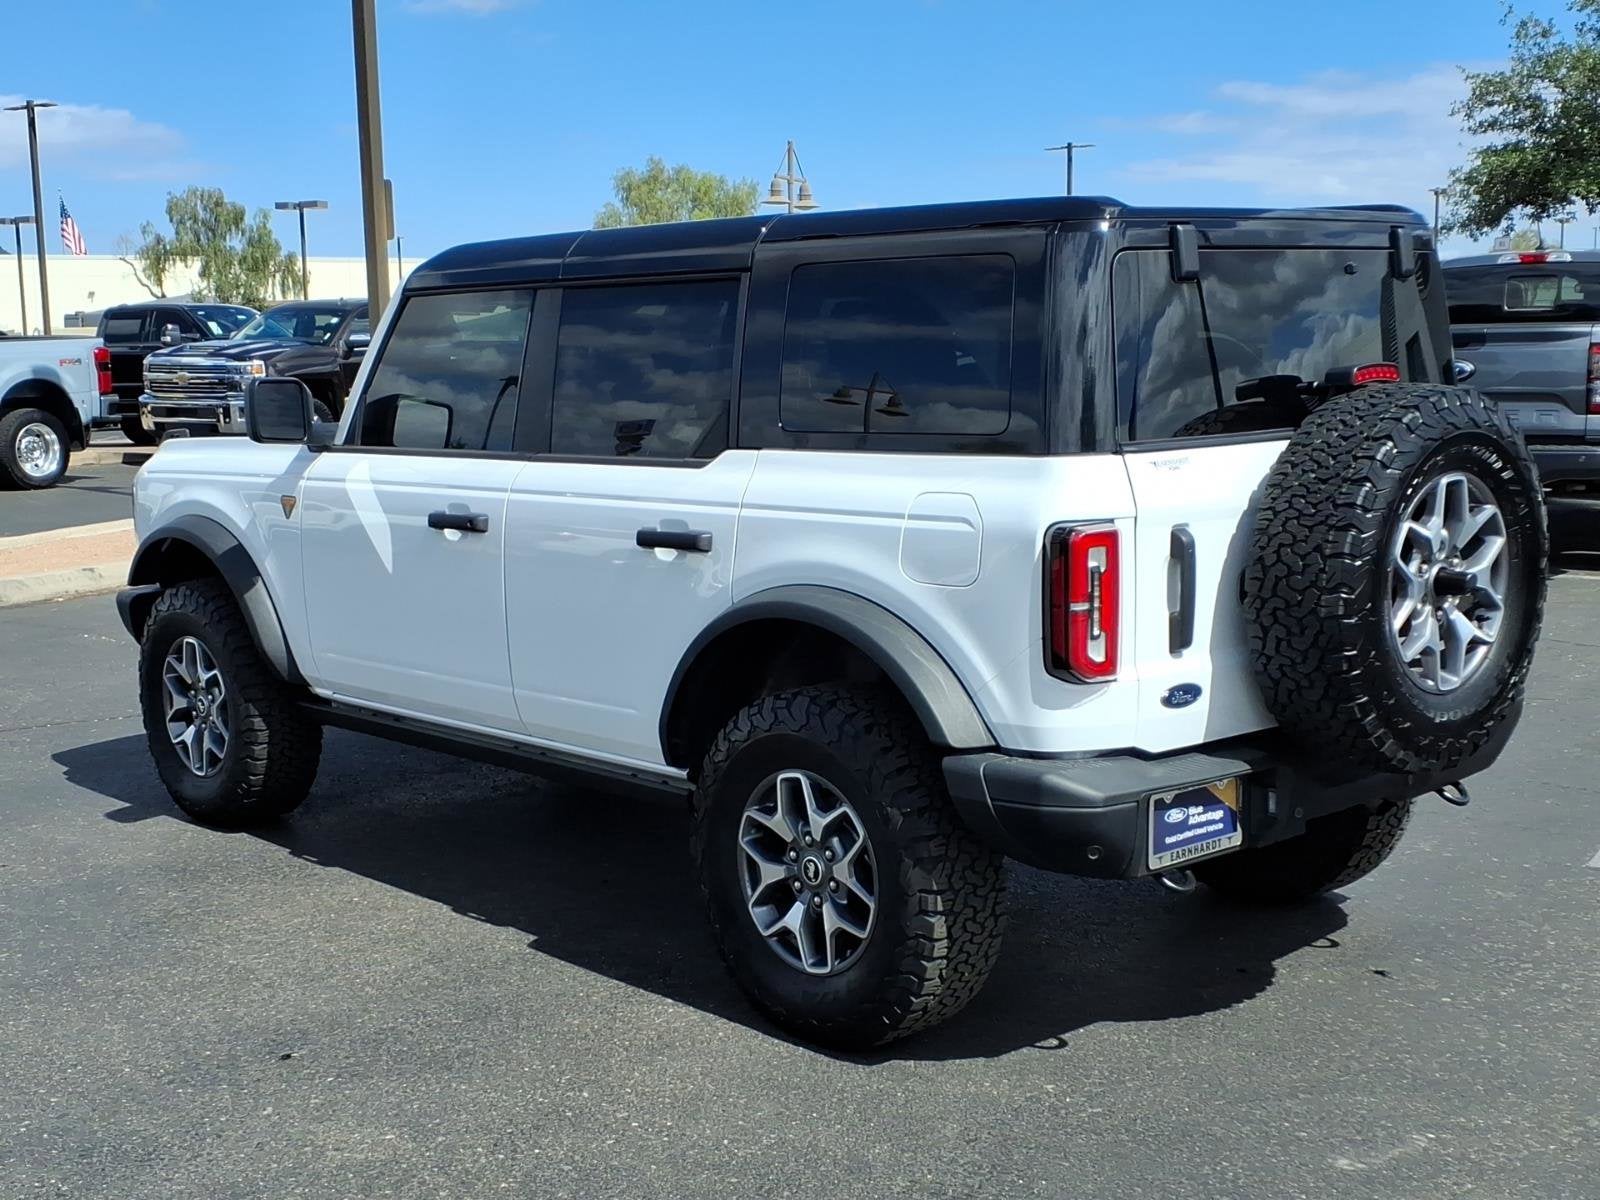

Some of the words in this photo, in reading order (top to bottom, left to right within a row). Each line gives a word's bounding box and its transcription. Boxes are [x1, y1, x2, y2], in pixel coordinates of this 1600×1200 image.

[59, 357, 82, 367] FX4
[1188, 810, 1224, 825] Advantage
[1170, 838, 1222, 862] EARNHARDT
